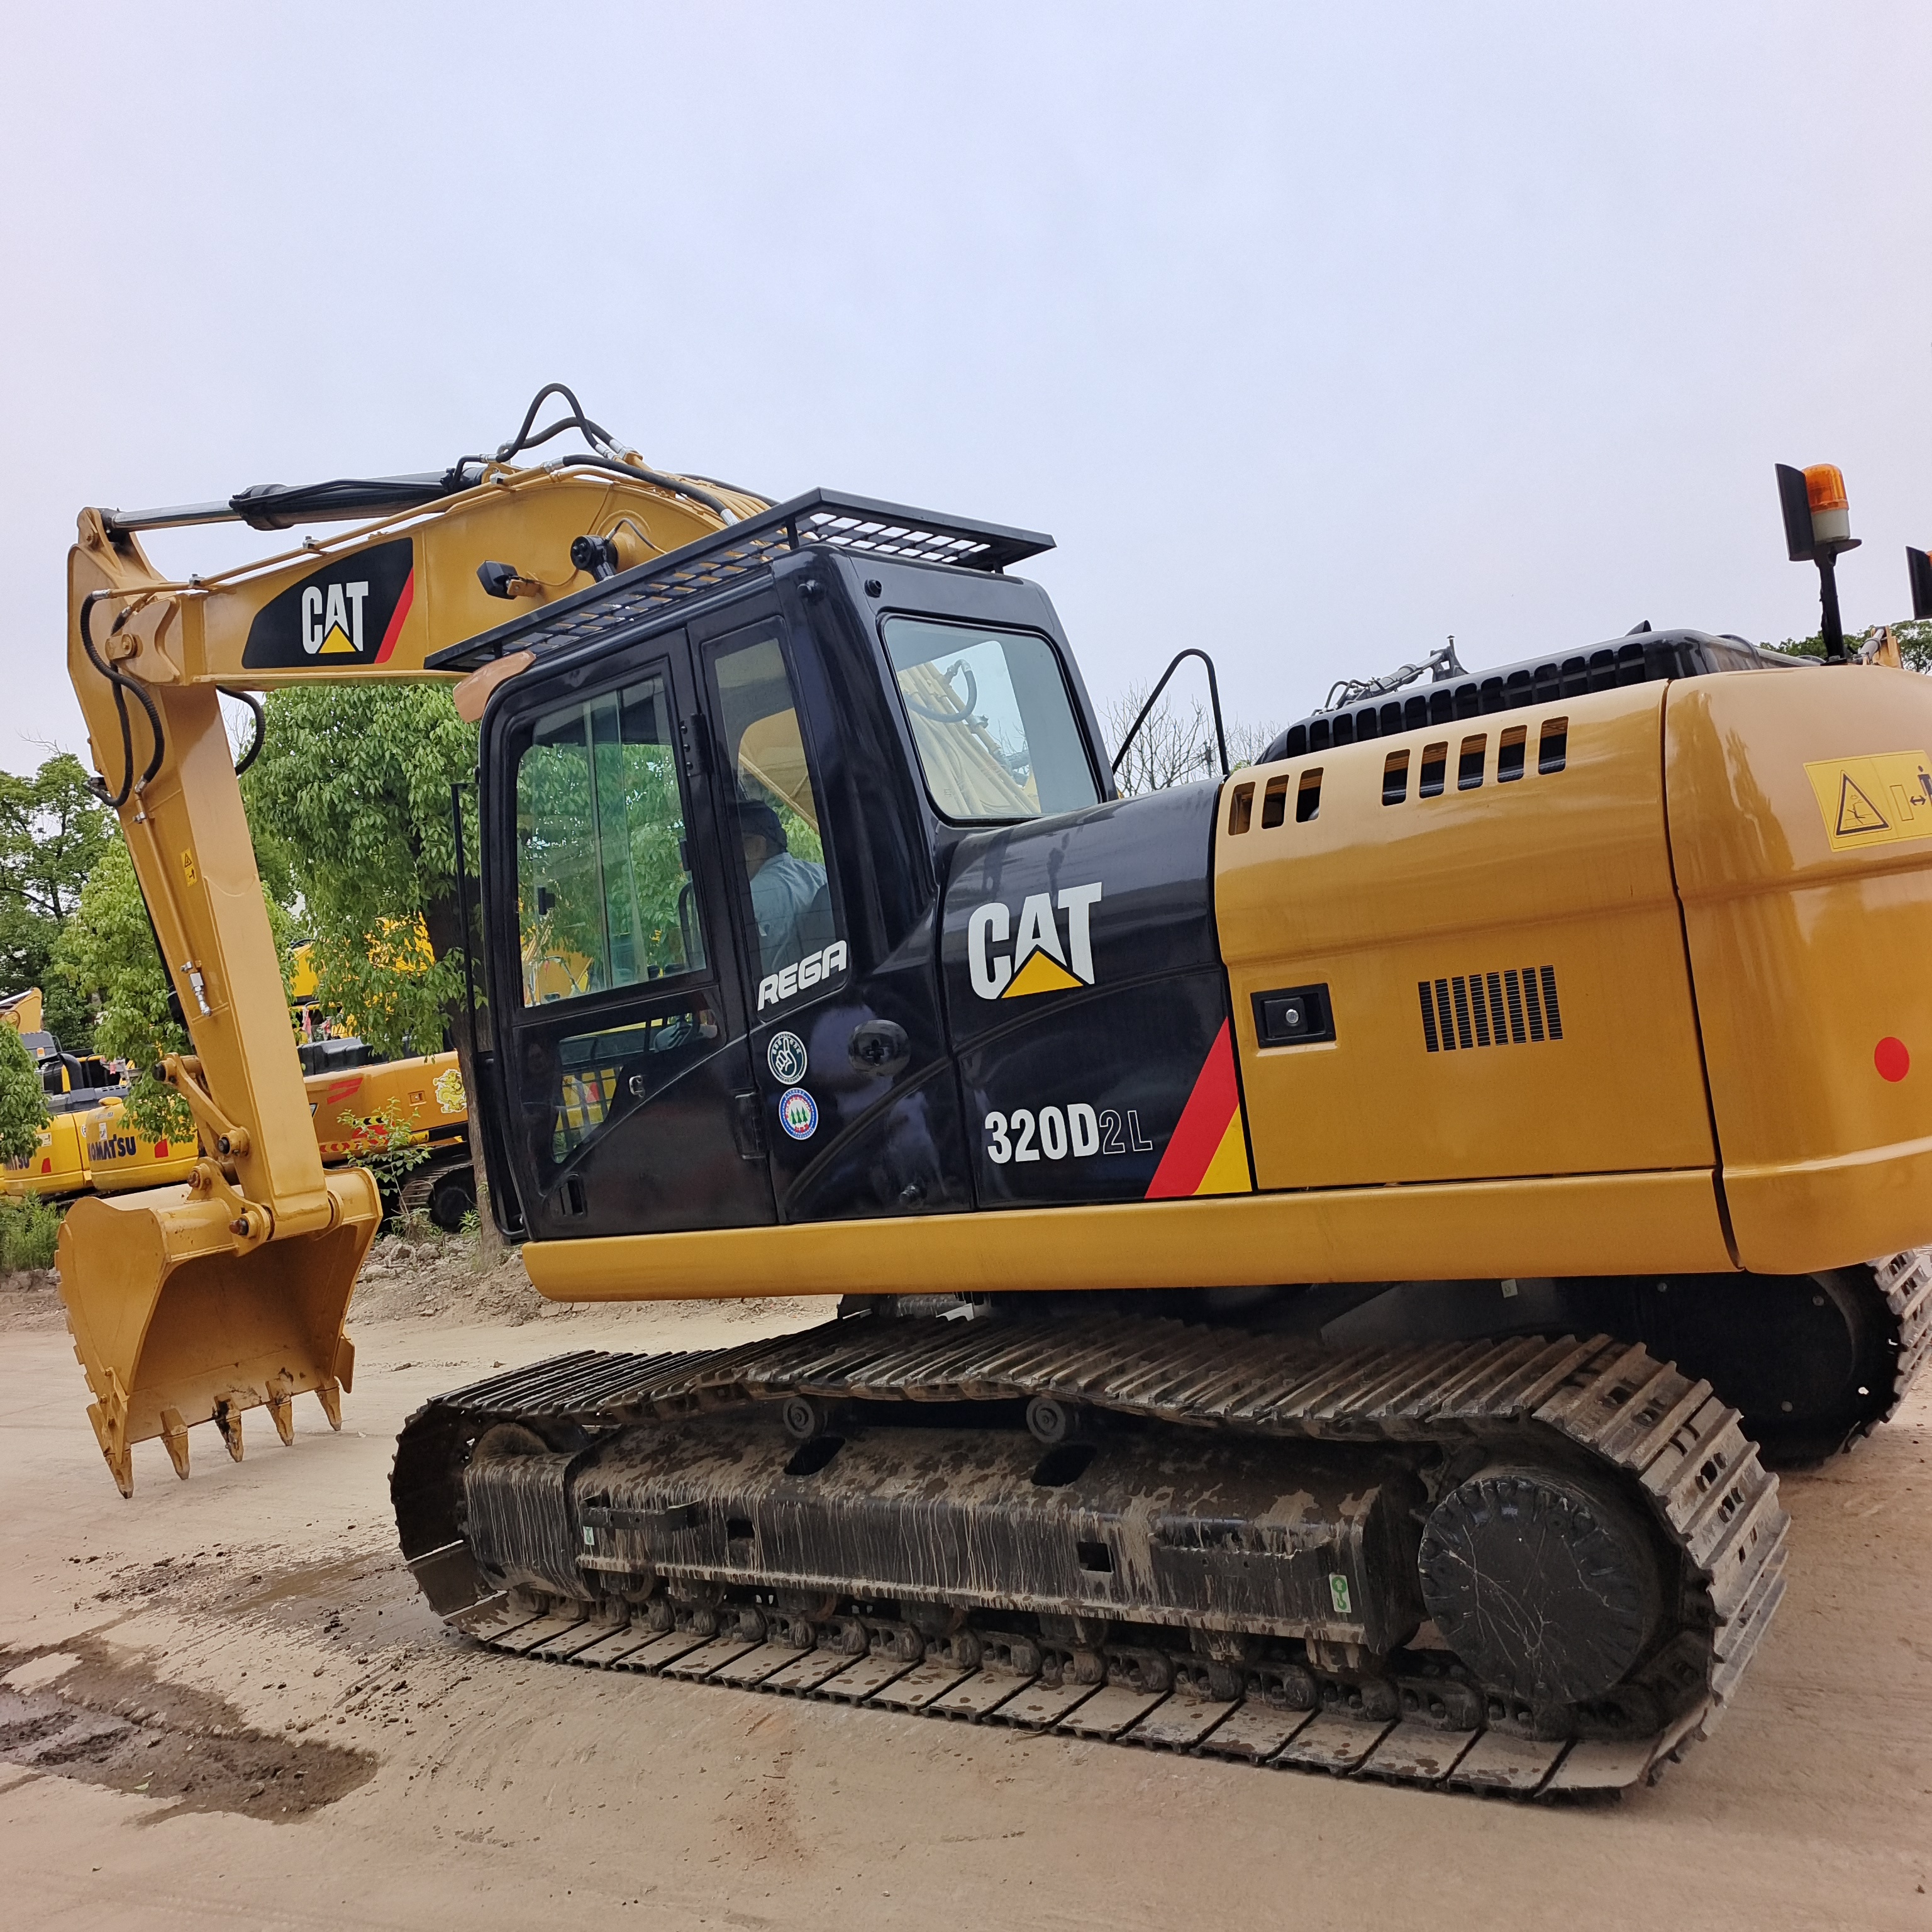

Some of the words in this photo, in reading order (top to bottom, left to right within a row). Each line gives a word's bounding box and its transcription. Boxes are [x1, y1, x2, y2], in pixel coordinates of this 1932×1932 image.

[302, 581, 369, 654] CAT
[757, 940, 847, 1011] REGA
[968, 882, 1102, 1000] CAT
